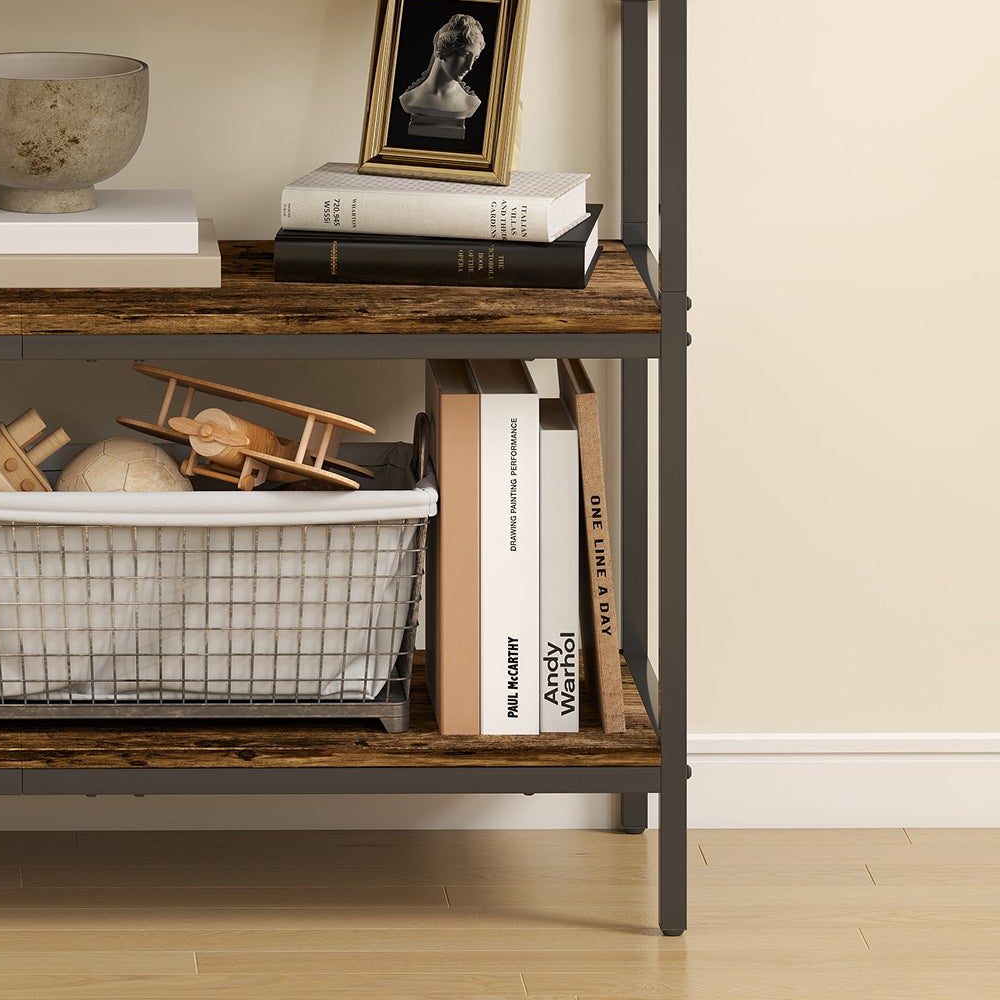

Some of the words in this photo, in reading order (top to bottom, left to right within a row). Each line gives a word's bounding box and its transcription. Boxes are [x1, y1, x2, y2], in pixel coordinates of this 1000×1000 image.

[490, 201, 498, 238] GARDENS
[510, 207, 518, 236] VILLAS
[510, 418, 518, 476] PERFORMANCE
[510, 478, 518, 514] PAINTING
[590, 495, 603, 530] ONE
[510, 516, 518, 552] DRAWING
[594, 538, 606, 578] LINE
[598, 586, 608, 596] A
[599, 602, 612, 636] DAY
[508, 636, 519, 690] McCARTHY
[543, 642, 563, 706] Andy
[560, 632, 575, 716] Warhol
[508, 693, 519, 719] PAUL
